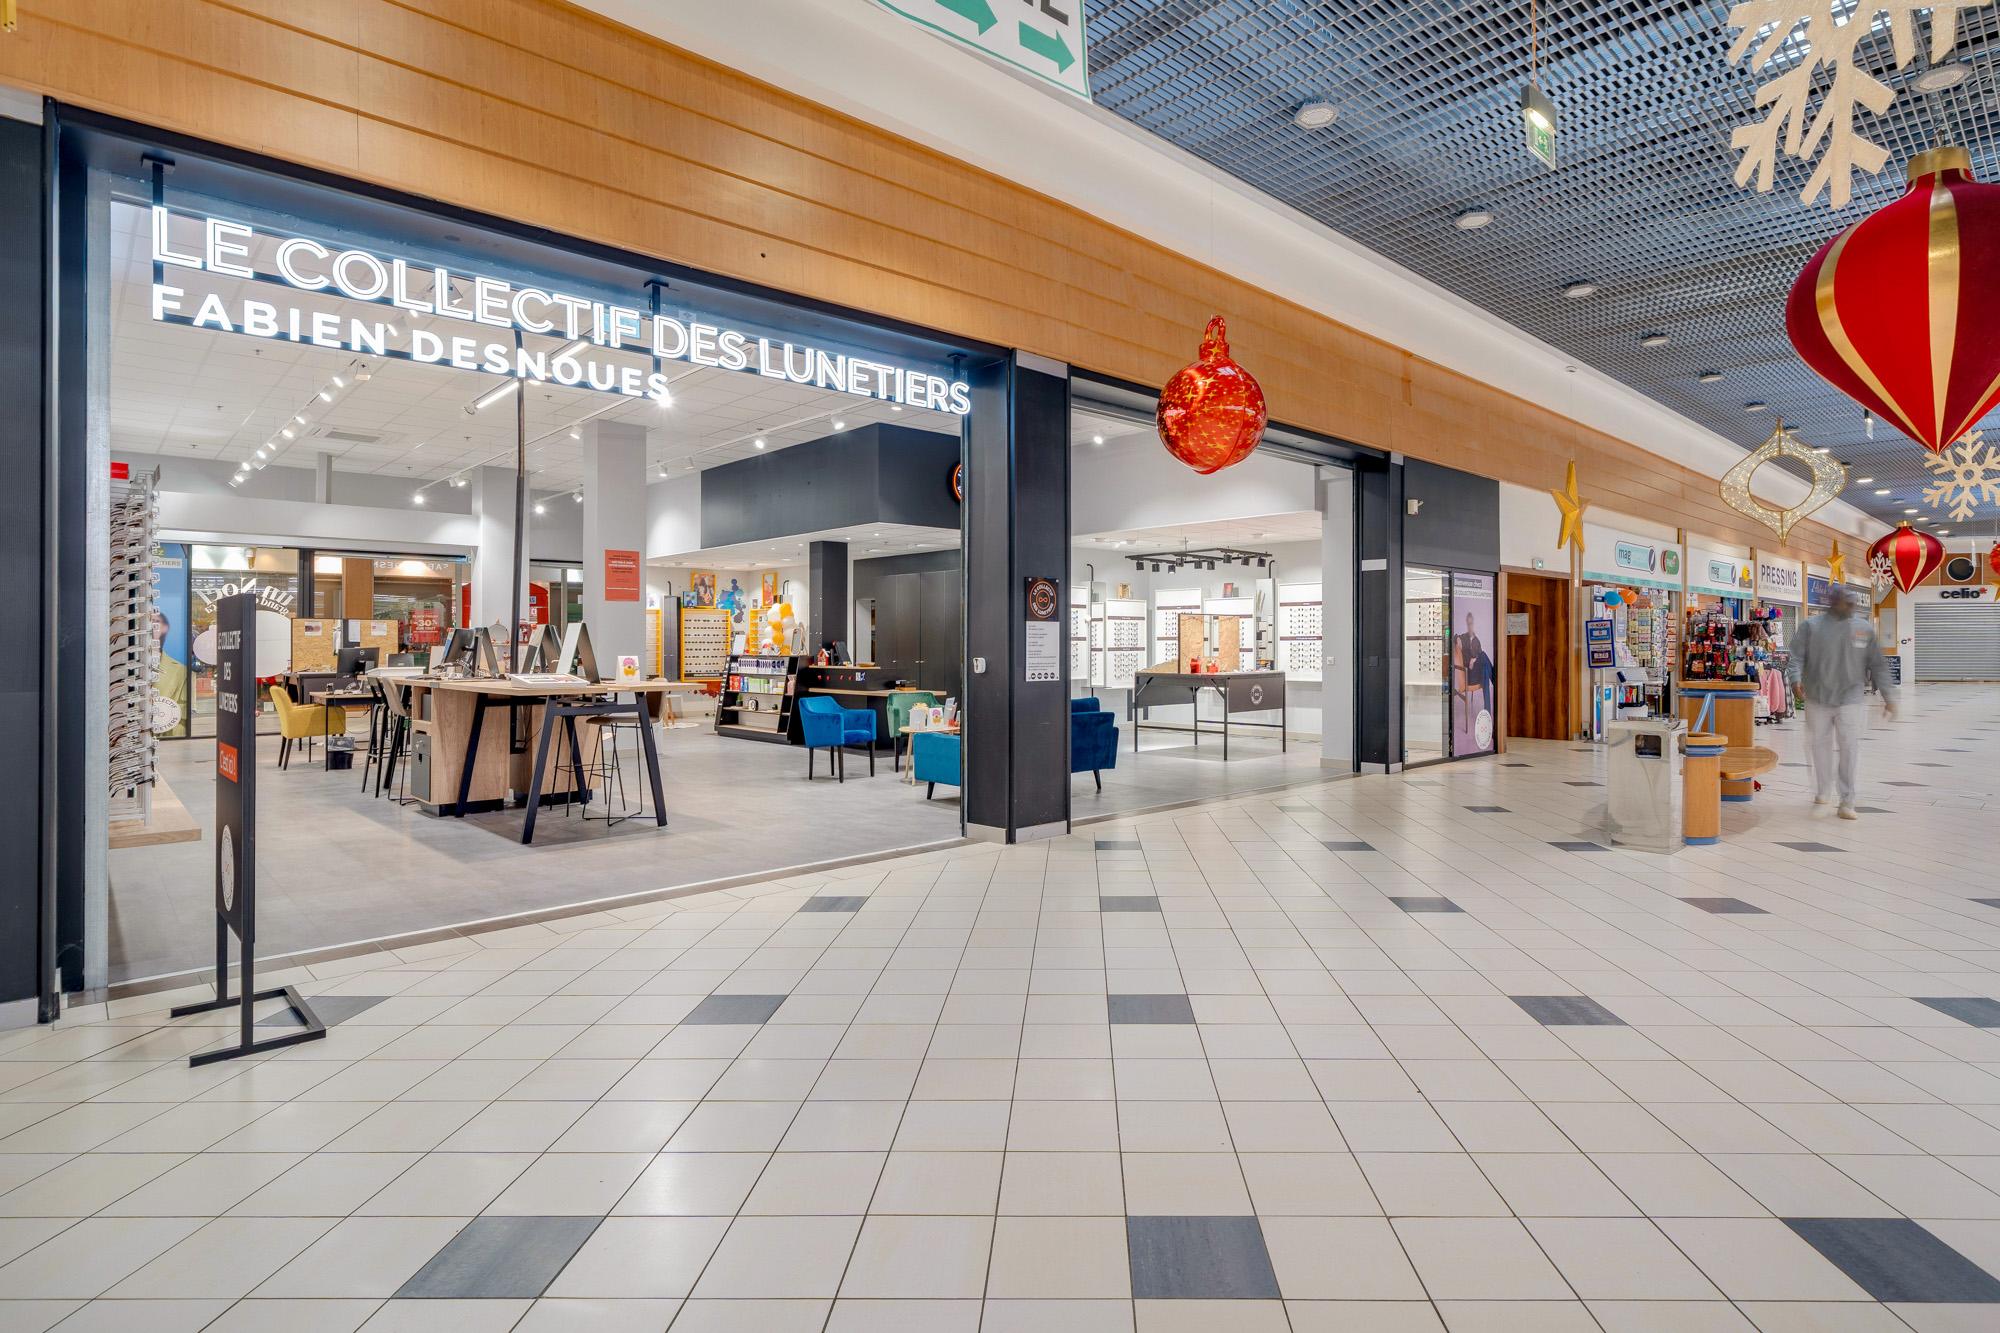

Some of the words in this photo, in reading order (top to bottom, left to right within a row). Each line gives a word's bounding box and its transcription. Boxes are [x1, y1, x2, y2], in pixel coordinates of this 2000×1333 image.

[152, 205, 254, 279] LE
[275, 238, 640, 348] COLLECTIF
[653, 314, 747, 371] DES
[758, 337, 972, 415] LUNETIERS
[152, 283, 385, 355] FABIEN
[412, 329, 670, 399] DESNOUES
[1618, 548, 1632, 565] mag
[1761, 564, 1797, 588] PRESSING
